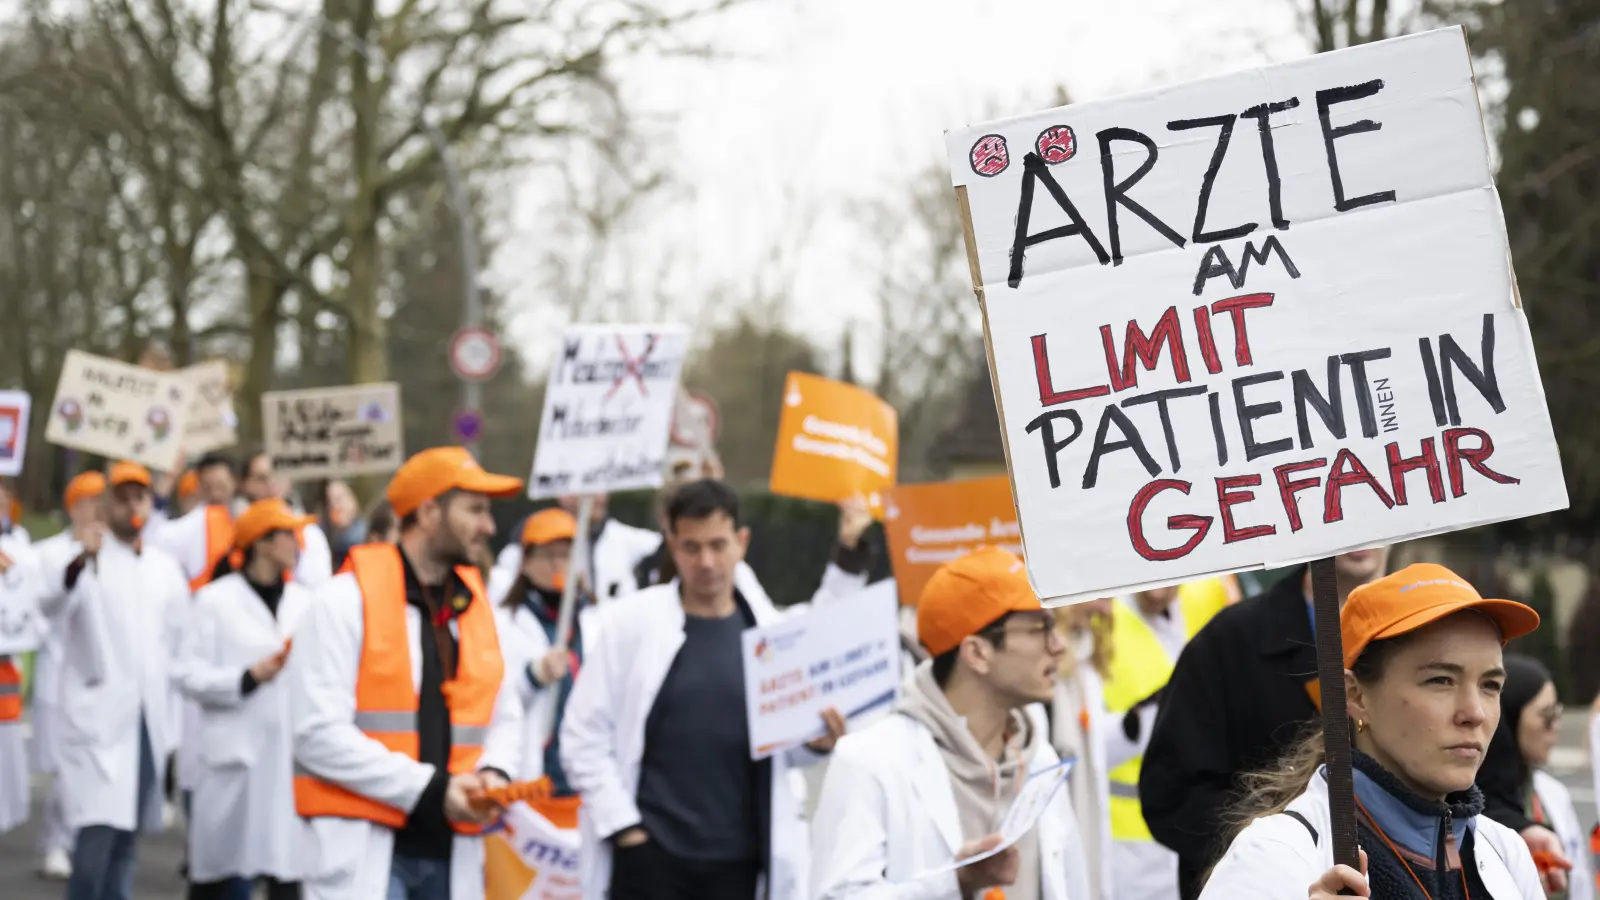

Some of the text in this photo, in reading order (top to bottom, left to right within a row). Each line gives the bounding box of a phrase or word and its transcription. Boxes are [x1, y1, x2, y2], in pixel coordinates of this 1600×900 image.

[970, 79, 1396, 288] ÄRZTE
[1192, 235, 1300, 296] AM
[1025, 314, 1506, 489] PATIENT IN
[1031, 293, 1275, 406] LIMIT
[1373, 377, 1400, 433] INNEN
[1127, 428, 1521, 562] GEFAHR
